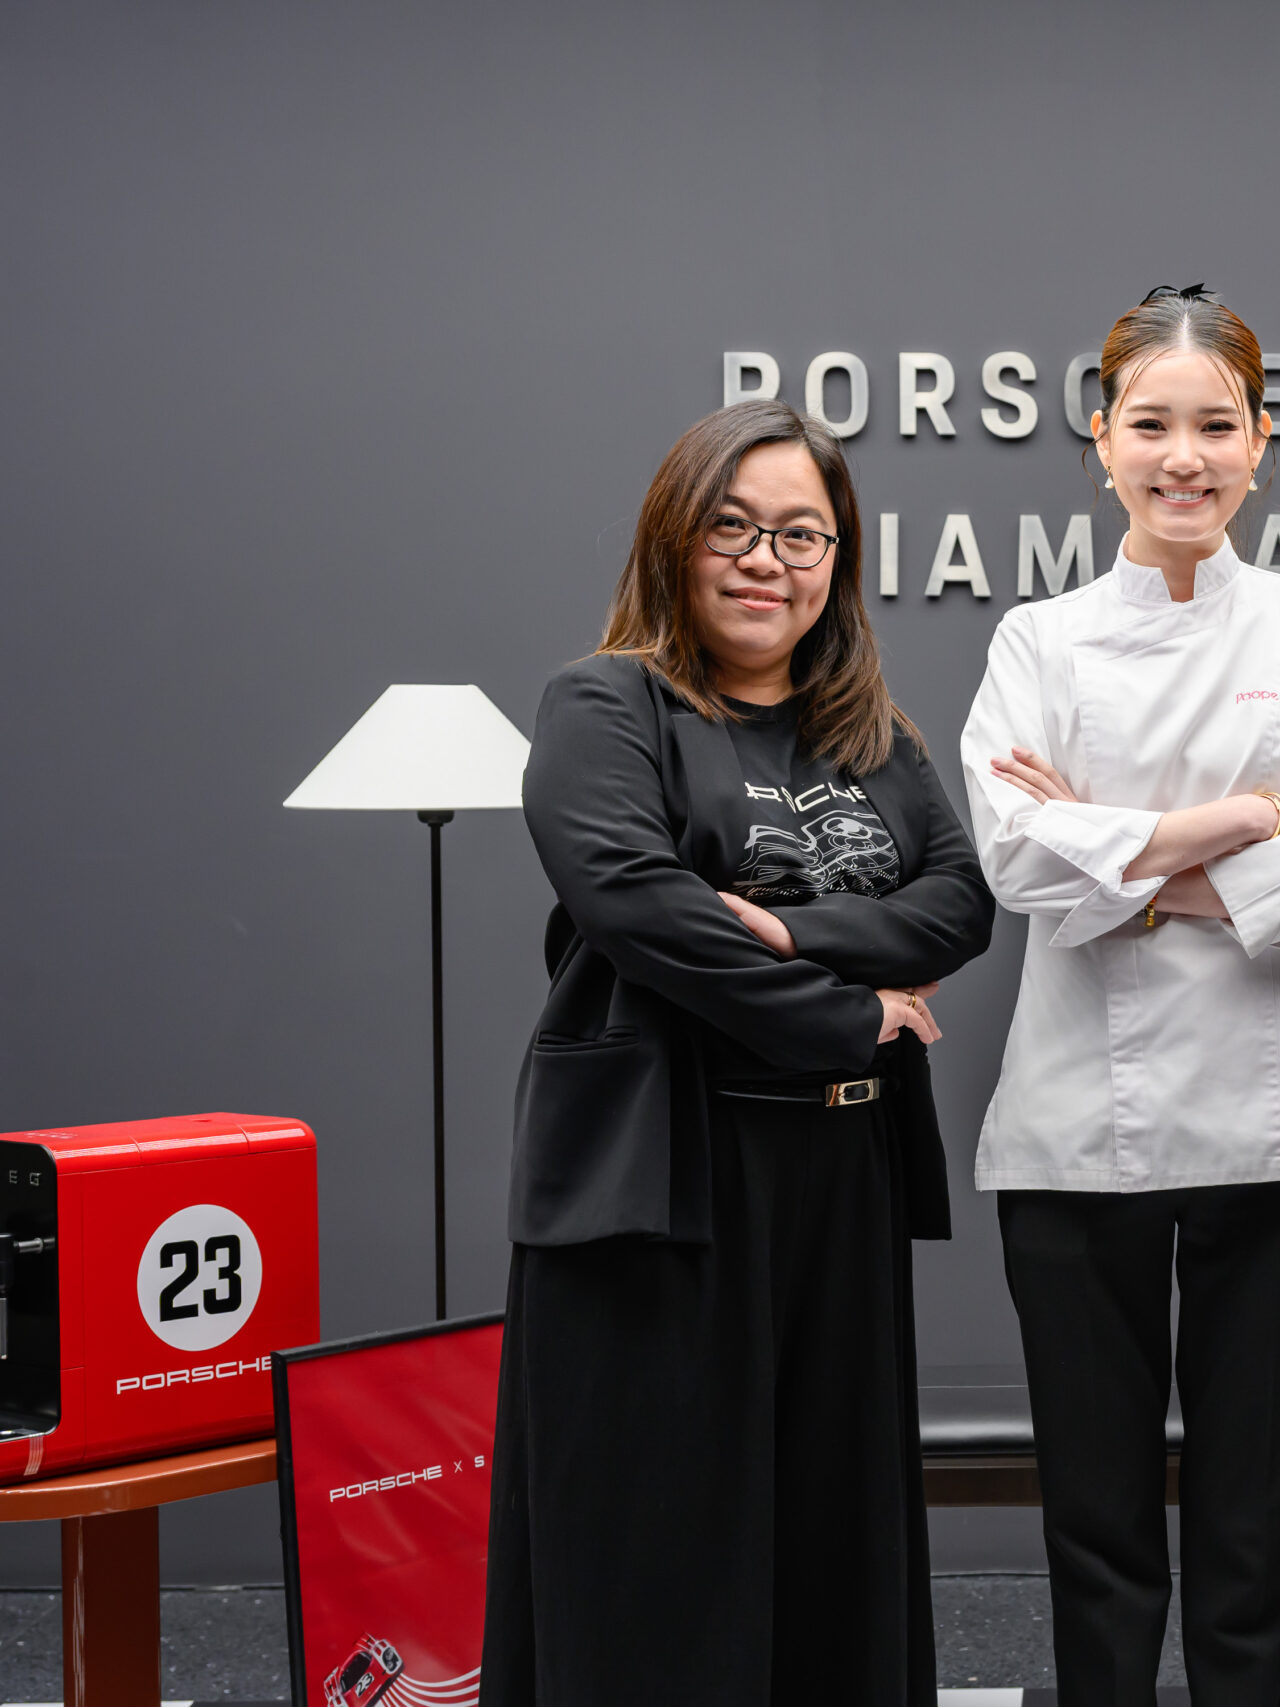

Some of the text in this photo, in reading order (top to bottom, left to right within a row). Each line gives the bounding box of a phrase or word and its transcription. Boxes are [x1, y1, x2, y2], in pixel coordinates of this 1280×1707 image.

[879, 512, 1094, 597] IAM
[9, 1170, 41, 1186] EG
[160, 1234, 242, 1322] 23
[116, 1356, 273, 1395] PORSCHE
[329, 1465, 443, 1502] PORSCHE
[355, 1672, 375, 1698] 23
